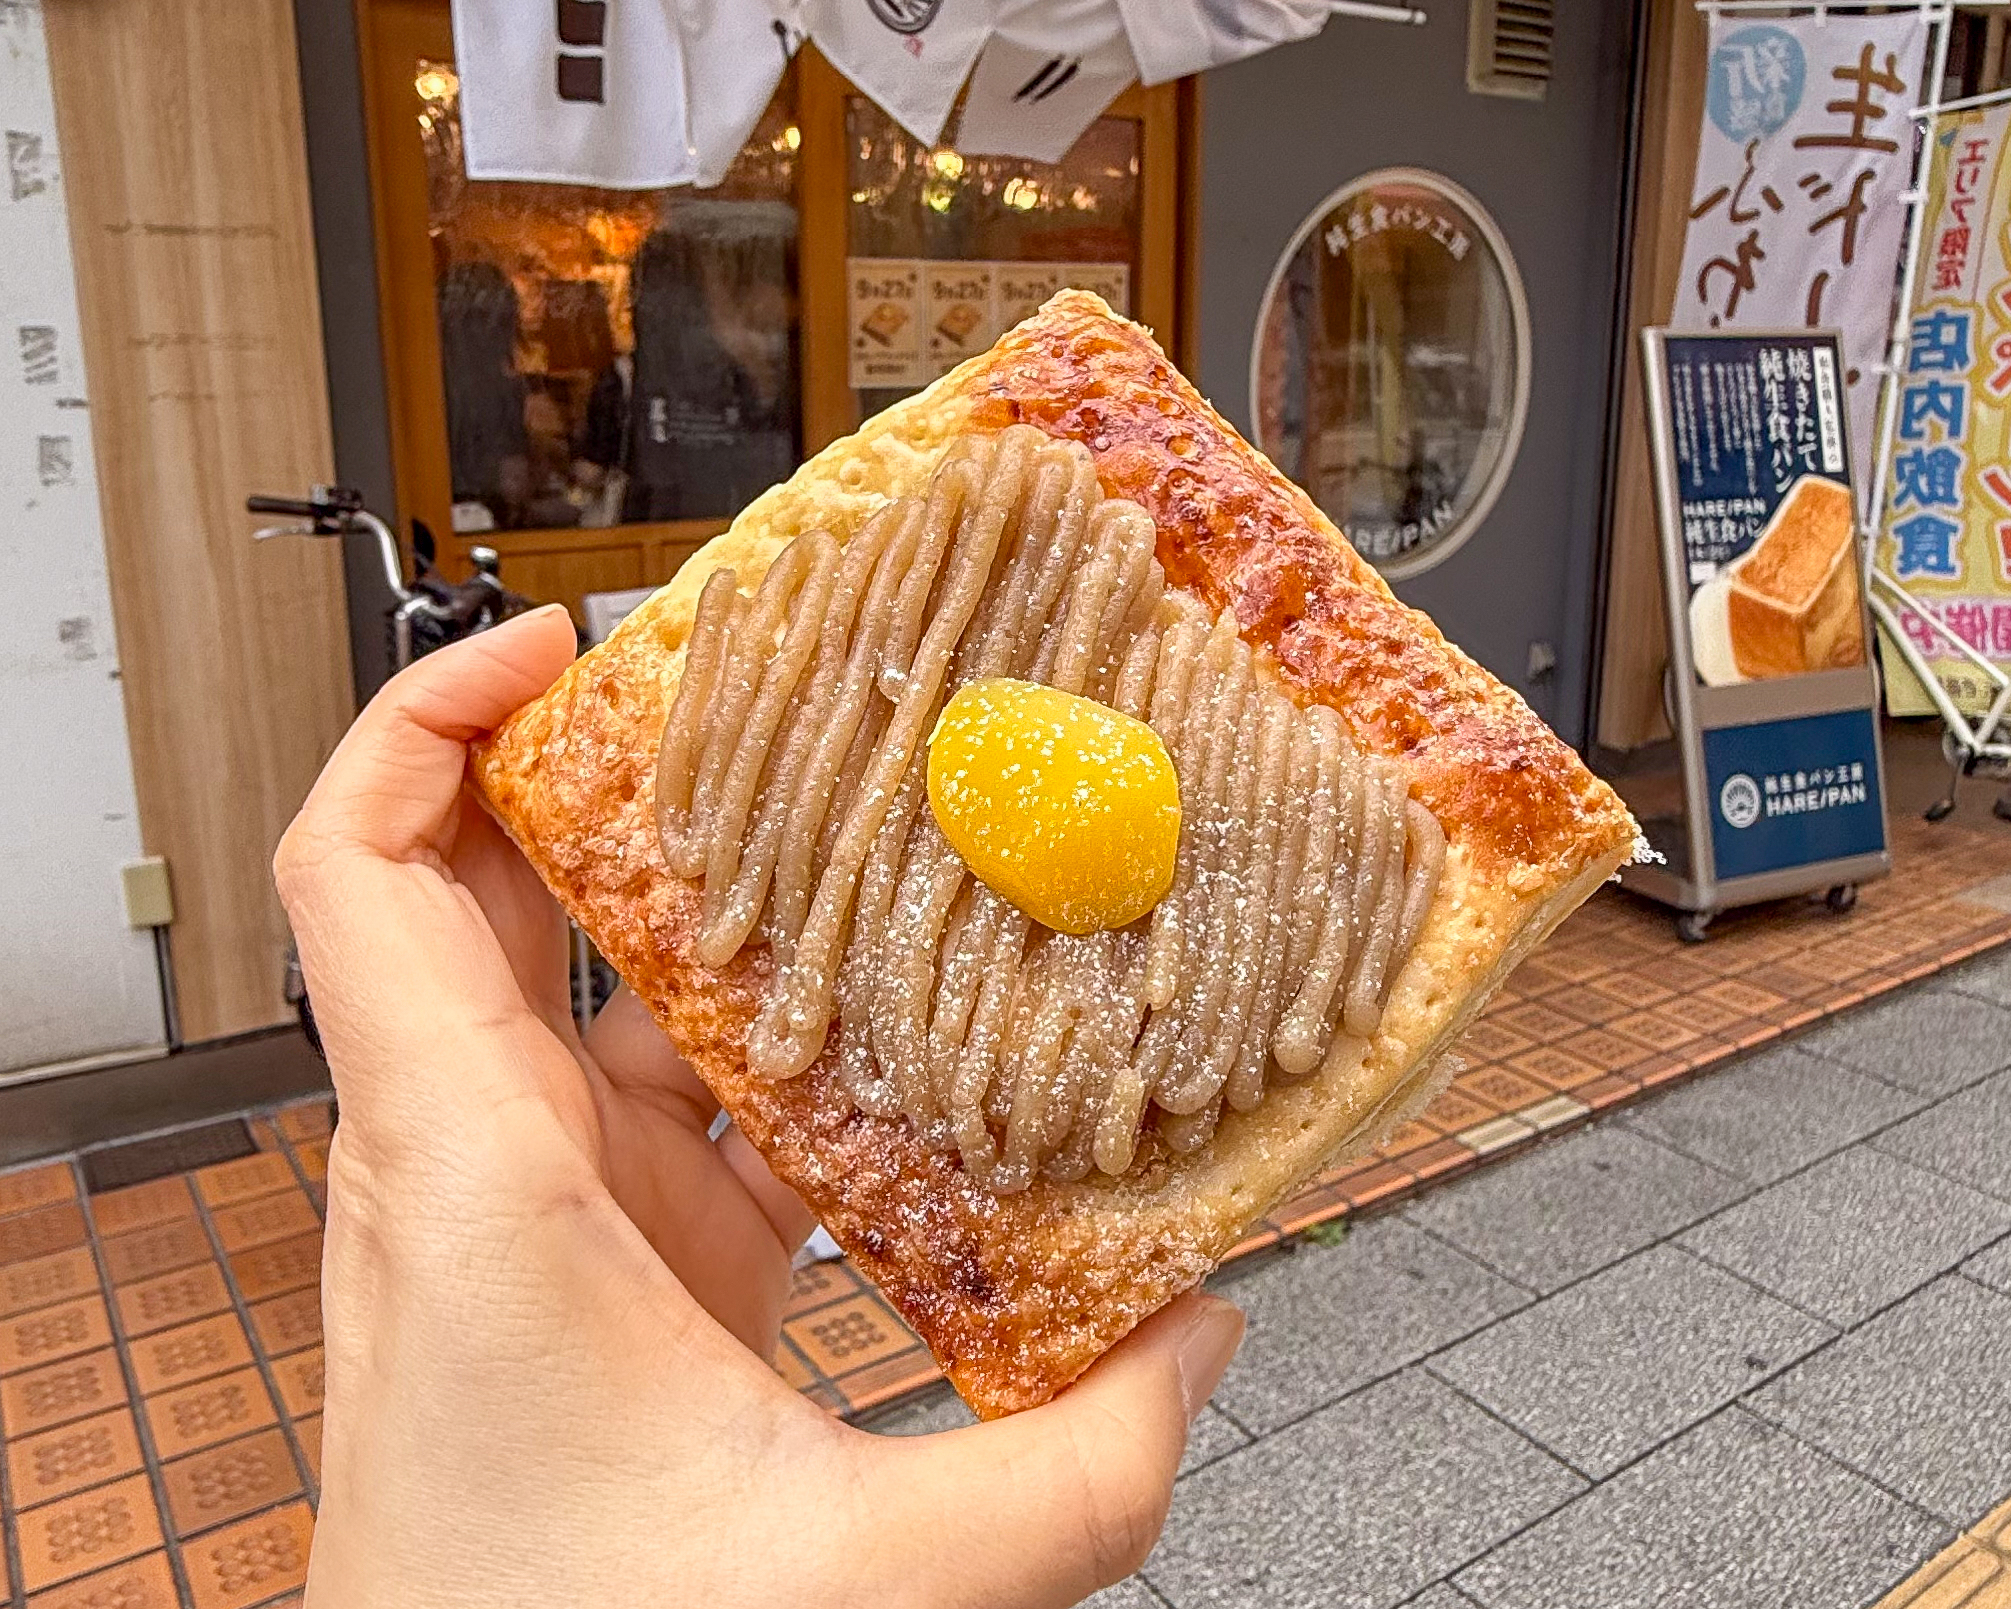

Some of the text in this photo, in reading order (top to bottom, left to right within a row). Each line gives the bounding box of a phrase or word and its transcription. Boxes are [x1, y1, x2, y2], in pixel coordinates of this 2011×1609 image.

[1759, 348, 1794, 494] 純生食パン
[1787, 348, 1819, 472] 焼きたて
[1683, 497, 1768, 518] HARE/PAN
[1767, 782, 1866, 817] HARE/PAN
